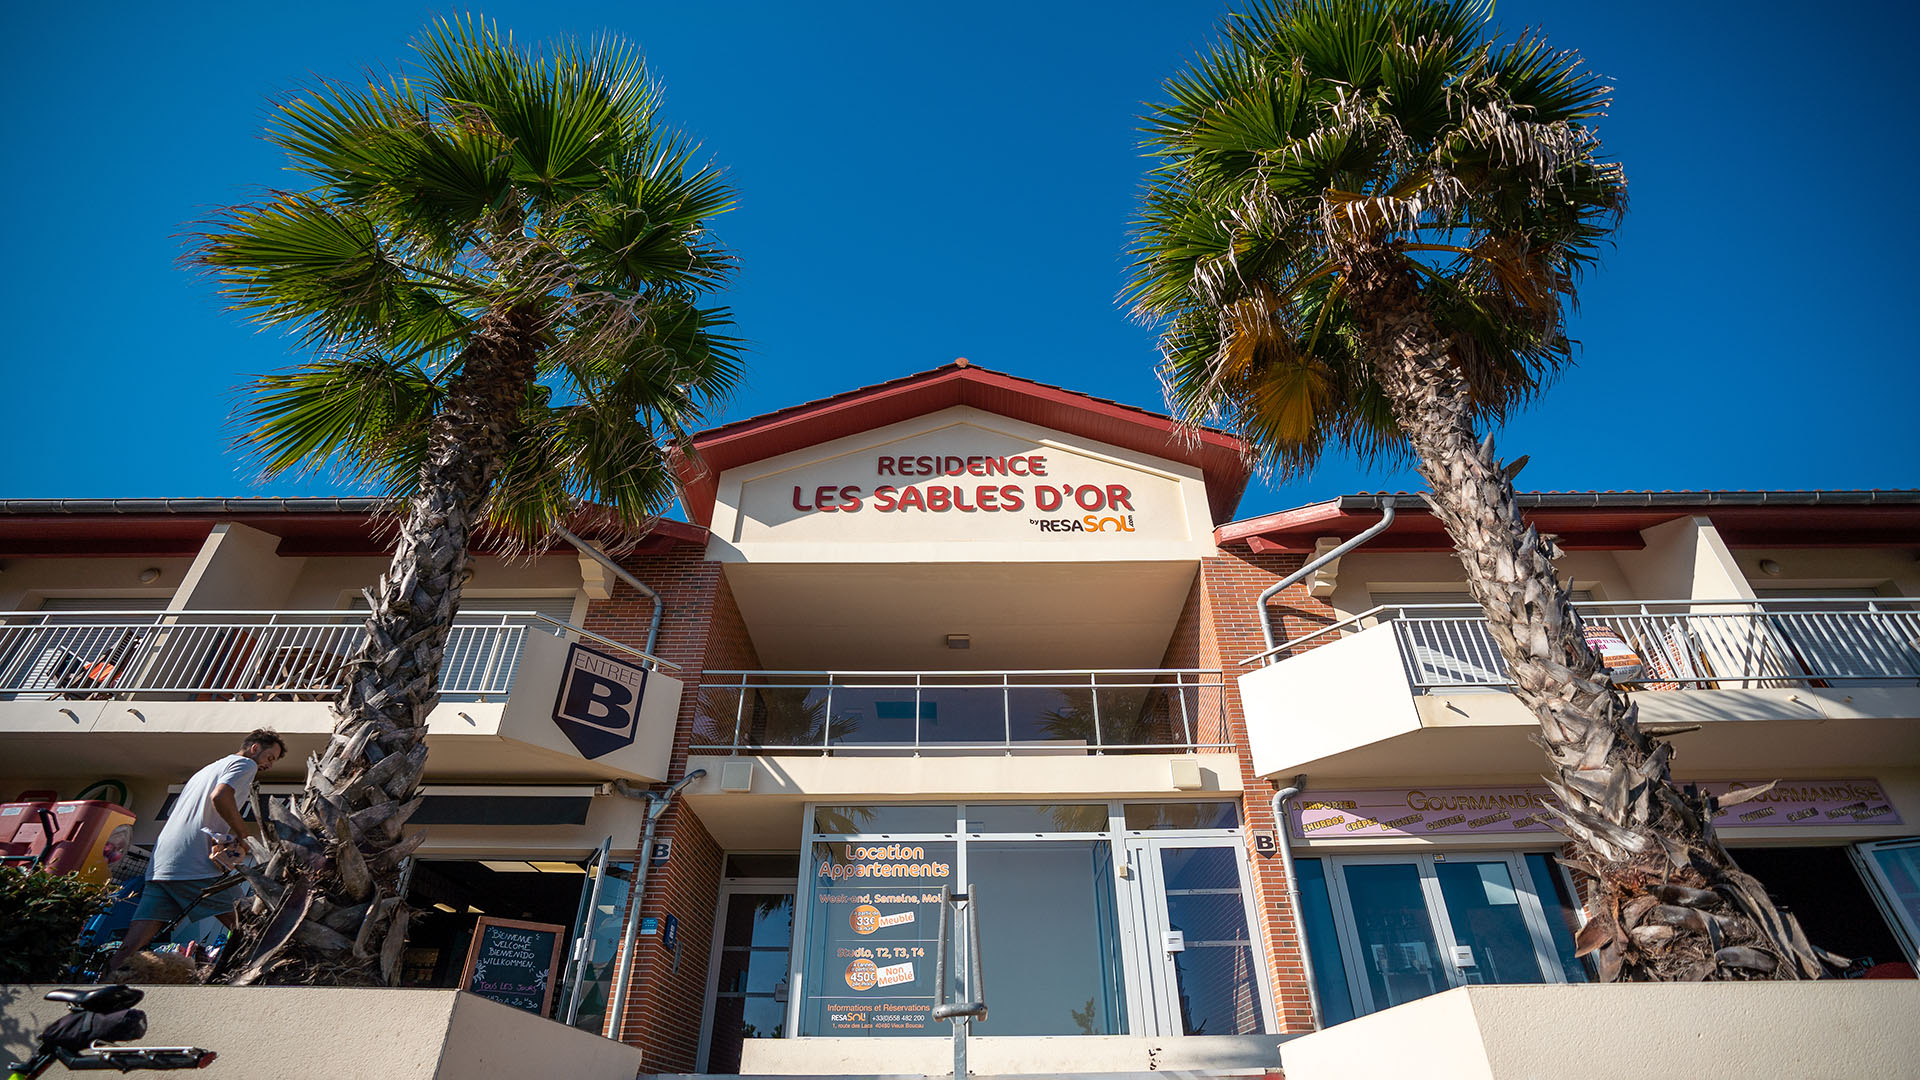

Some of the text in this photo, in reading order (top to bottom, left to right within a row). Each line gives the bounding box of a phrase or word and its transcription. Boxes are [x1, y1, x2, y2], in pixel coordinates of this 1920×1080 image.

[877, 455, 1047, 476] RESIDENCE
[792, 484, 1135, 512] LES SABLES D'OR
[575, 652, 640, 688] ENTREE
[563, 667, 633, 729] B
[1293, 800, 1358, 810] A EMPORTER
[1302, 815, 1345, 833] CHURROS
[1380, 813, 1424, 831] BEIGNETS
[1425, 813, 1467, 831] GAUFRES
[1256, 835, 1274, 850] B
[653, 843, 669, 858] B
[846, 843, 925, 860] Location
[819, 861, 950, 880] Appartements
[819, 893, 873, 905] Week-end,
[874, 893, 921, 905] Semaine,
[856, 916, 875, 926] 33€
[880, 913, 914, 927] Meublé
[493, 940, 531, 951] WELCOME
[837, 947, 925, 959] Studio, T2, T3, T4
[850, 972, 876, 982] 450€
[879, 970, 914, 986] Meublé
[886, 967, 904, 976] Non
[500, 982, 513, 990] LES
[827, 1003, 931, 1012] Informations et Réservations
